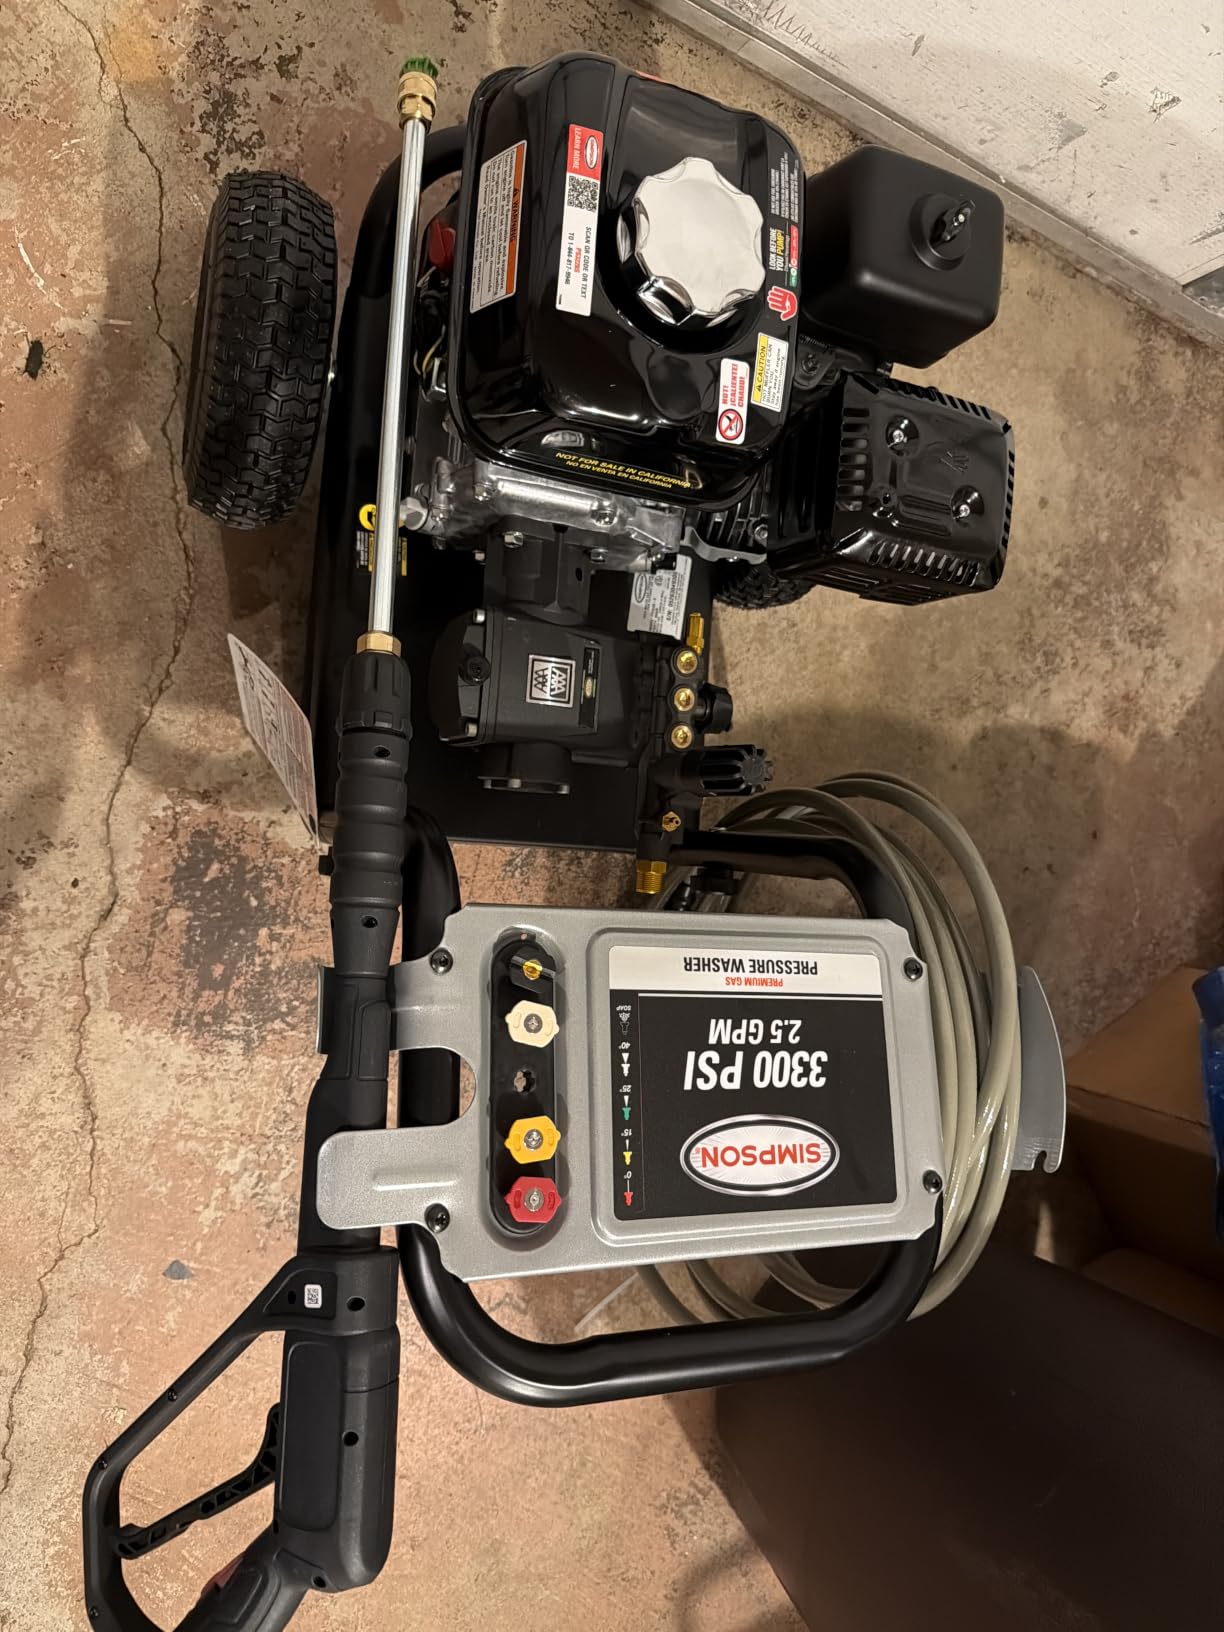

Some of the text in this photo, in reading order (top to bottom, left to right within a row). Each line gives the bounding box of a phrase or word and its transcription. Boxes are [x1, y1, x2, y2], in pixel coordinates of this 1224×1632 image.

[572, 127, 582, 169] LEARN MORE
[510, 199, 519, 243] WARNING
[568, 232, 574, 241] TO
[776, 229, 784, 271] YOU PUMP!
[582, 273, 588, 282] OR
[757, 345, 766, 383] CAUTION
[556, 452, 578, 462] NOT
[579, 457, 599, 466] FOR
[600, 462, 625, 472] SALE
[637, 470, 691, 488] CALIFORNIA
[592, 466, 616, 476] VENTA
[629, 475, 672, 489] CALIFORNIA
[683, 956, 818, 976] PRESSURE WASHER
[725, 976, 784, 988] PREMIUM GAS
[618, 1041, 630, 1049] 40°
[708, 1018, 803, 1045] 2.5 GPM
[683, 1050, 829, 1091] 3300 PSI
[620, 1128, 632, 1136] 15°
[700, 1142, 822, 1169] SIMPSON
